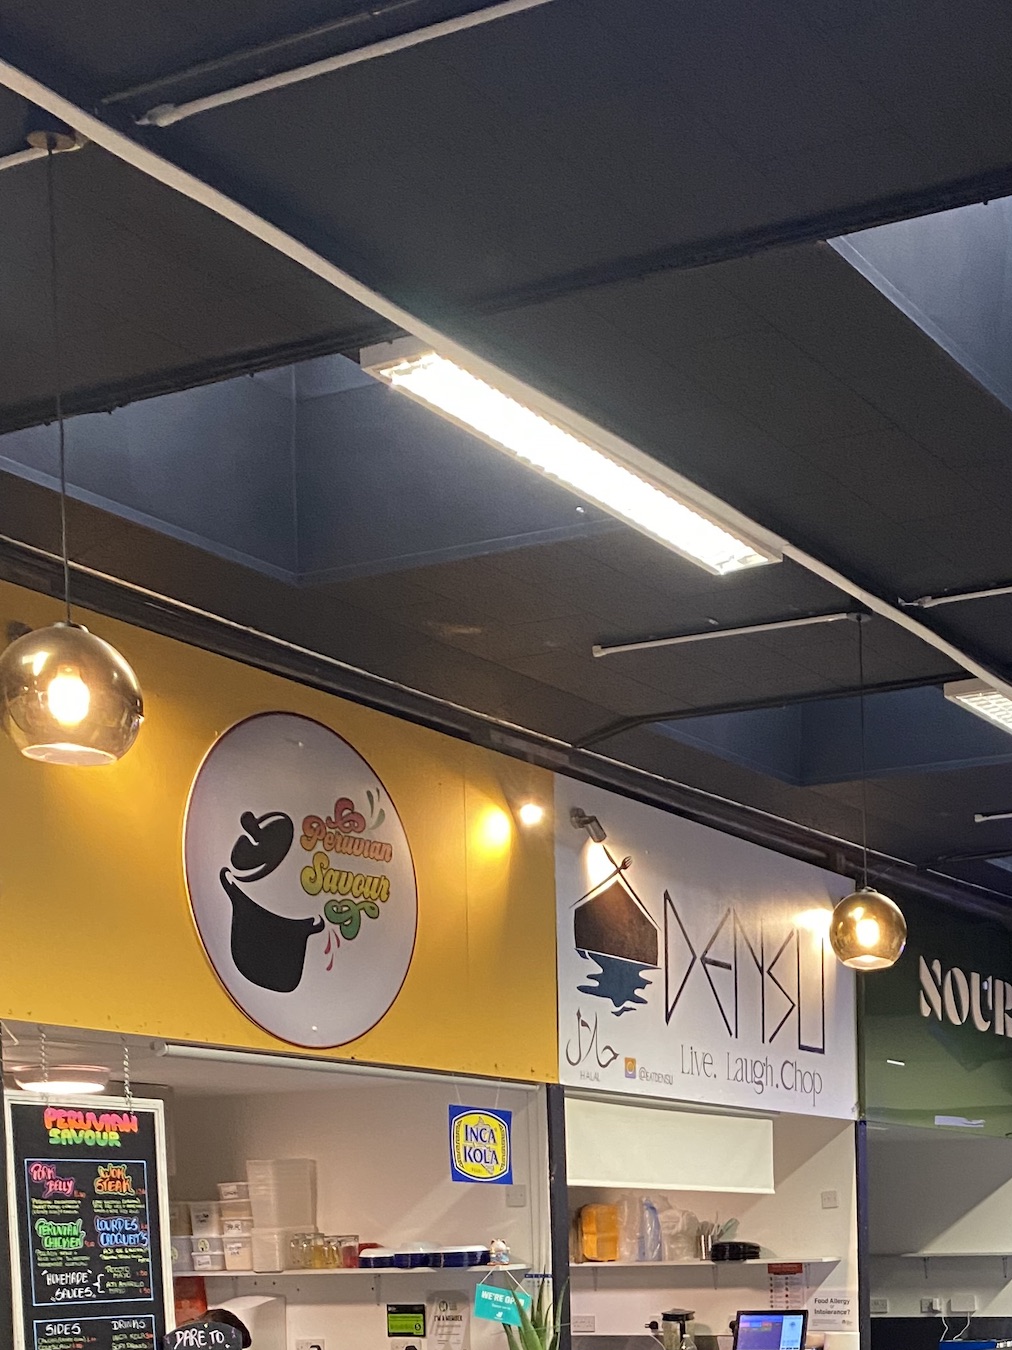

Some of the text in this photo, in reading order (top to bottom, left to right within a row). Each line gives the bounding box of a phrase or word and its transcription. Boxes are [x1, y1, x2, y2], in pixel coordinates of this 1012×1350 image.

[300, 814, 392, 863] Peruvian
[300, 852, 391, 902] Savour
[681, 1045, 717, 1079] Live.
[579, 1070, 602, 1082] HALAL
[44, 1107, 138, 1133] PERUVIAN
[48, 1128, 121, 1147] SAVOUR
[465, 1124, 497, 1143] INCA
[463, 1146, 499, 1165] KOLA
[45, 1323, 81, 1336] SIDES
[174, 1328, 224, 1350] DARE TO
